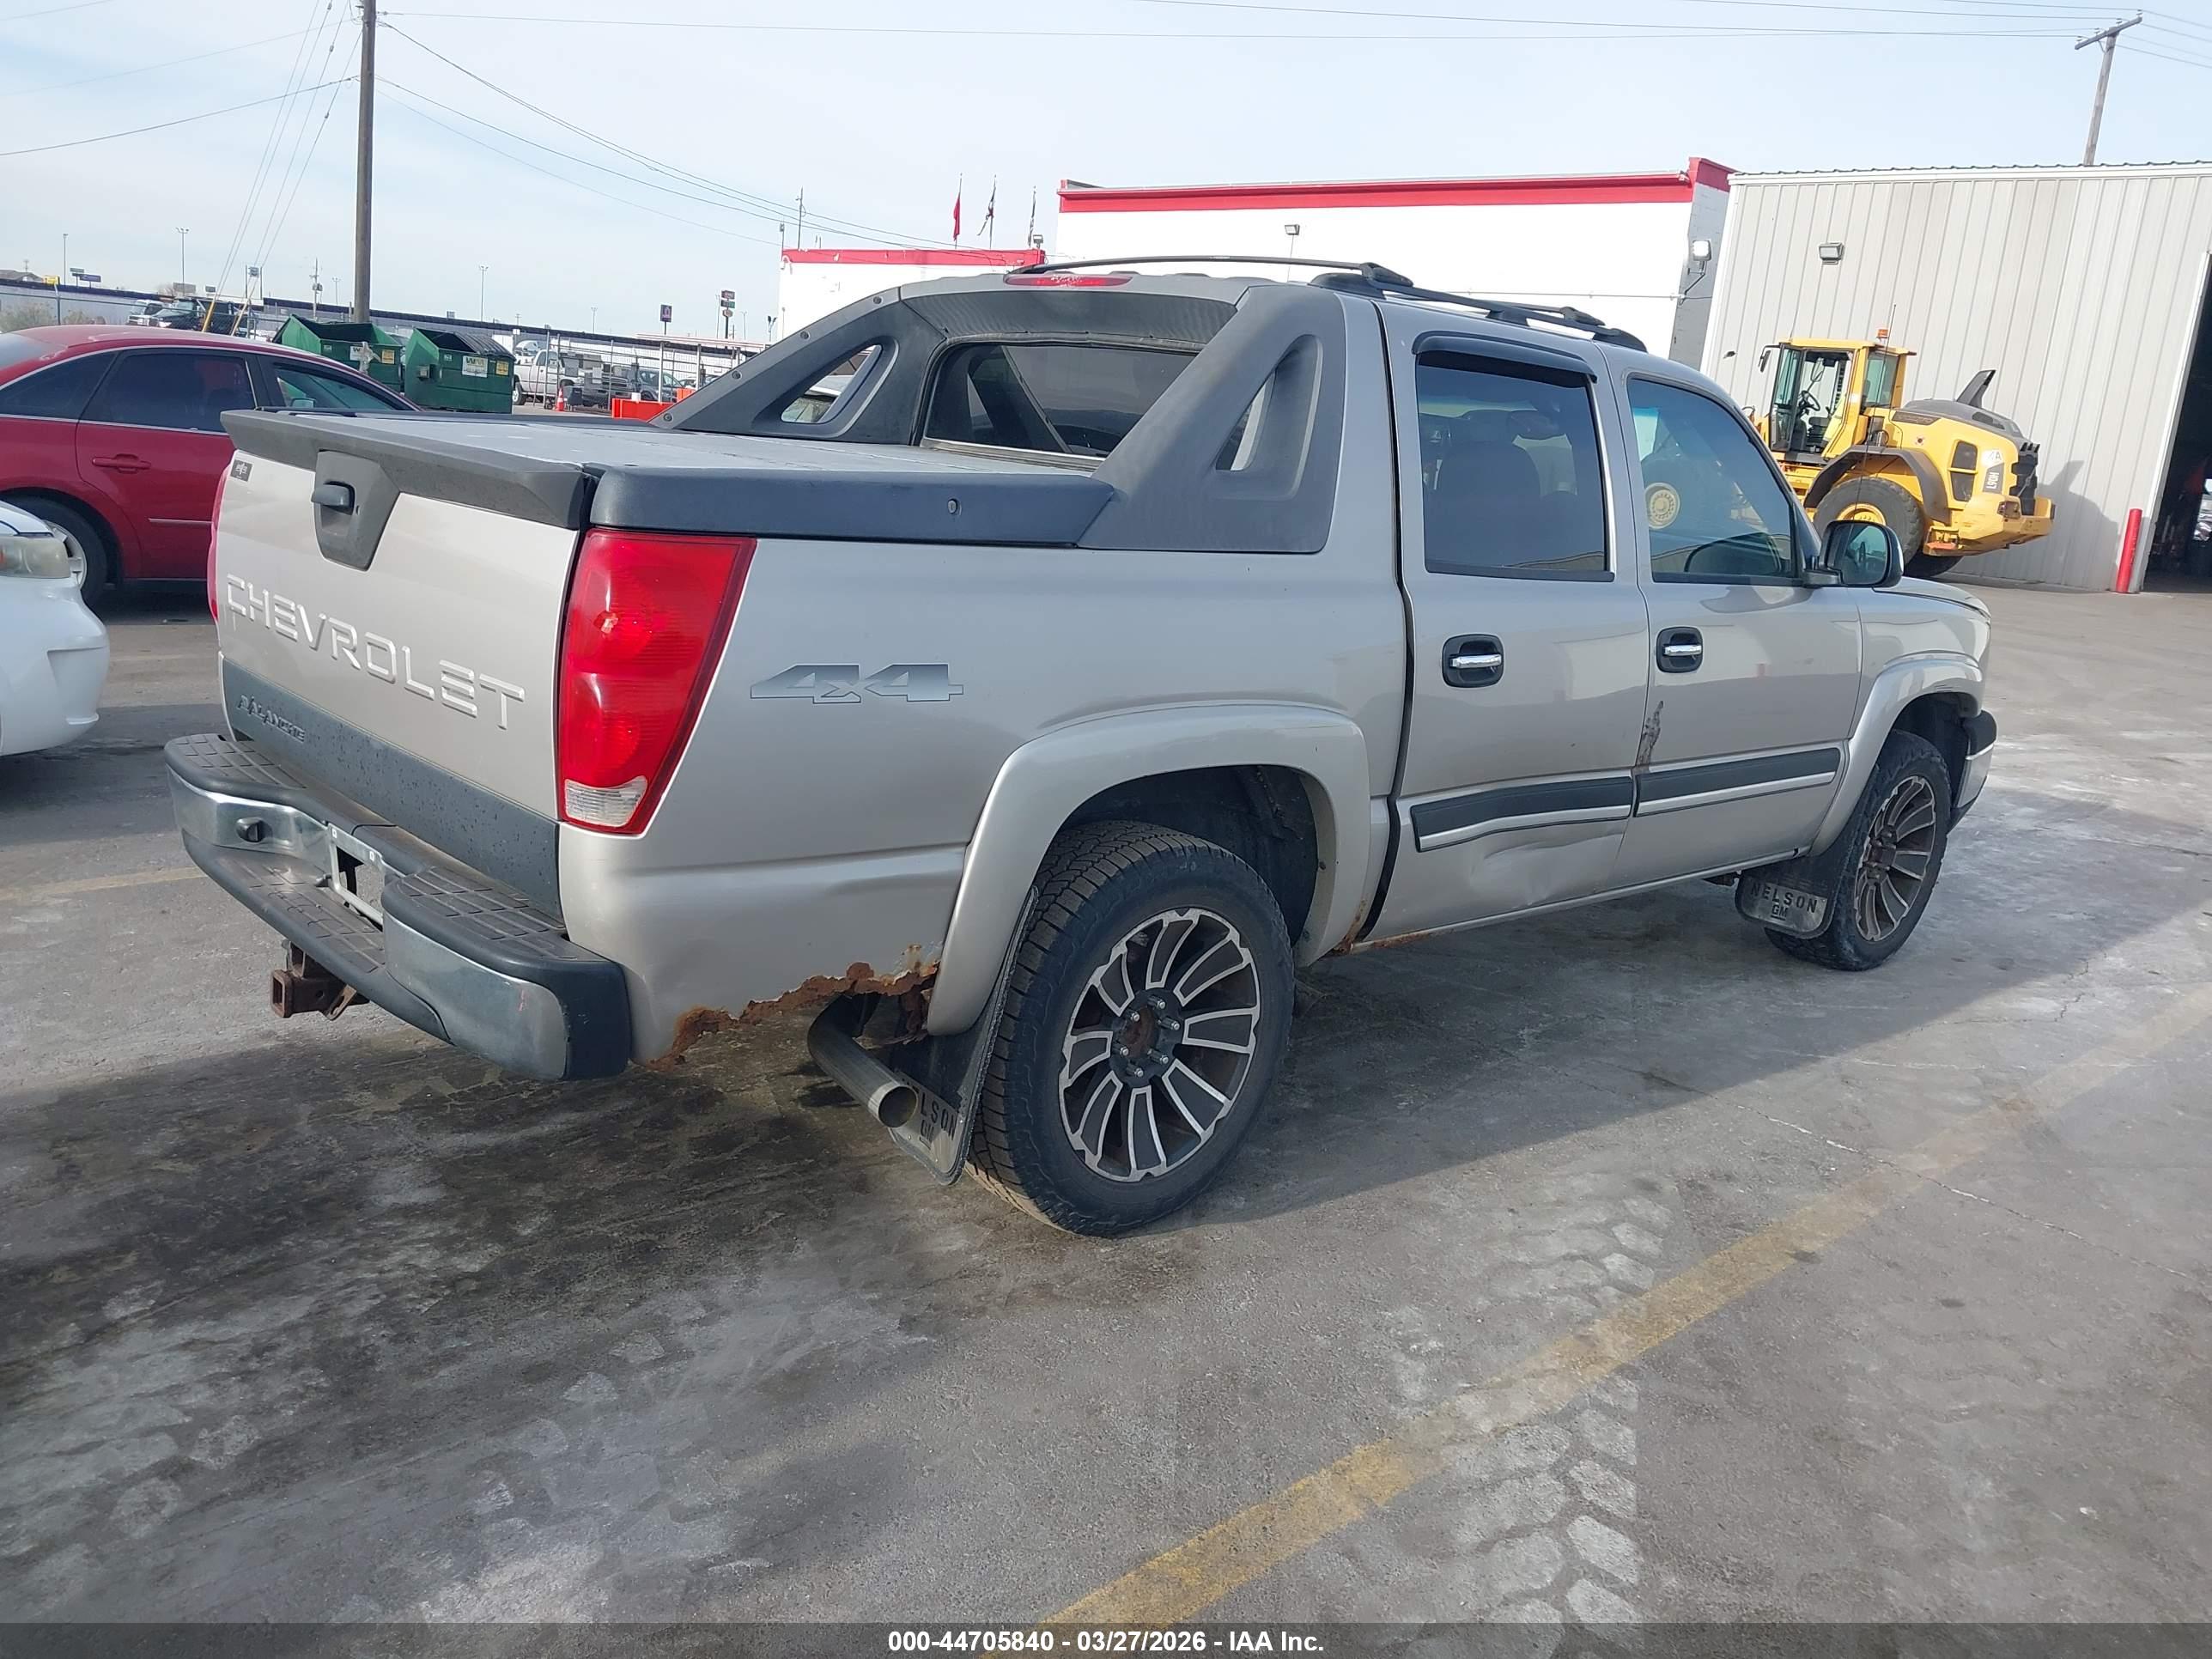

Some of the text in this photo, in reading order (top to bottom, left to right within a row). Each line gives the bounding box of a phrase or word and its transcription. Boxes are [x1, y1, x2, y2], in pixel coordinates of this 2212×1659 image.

[228, 573, 526, 730] CHEVROLET
[237, 694, 306, 744] AVALANCHE
[1751, 882, 1818, 914] NELSON
[1771, 904, 1789, 919] GM
